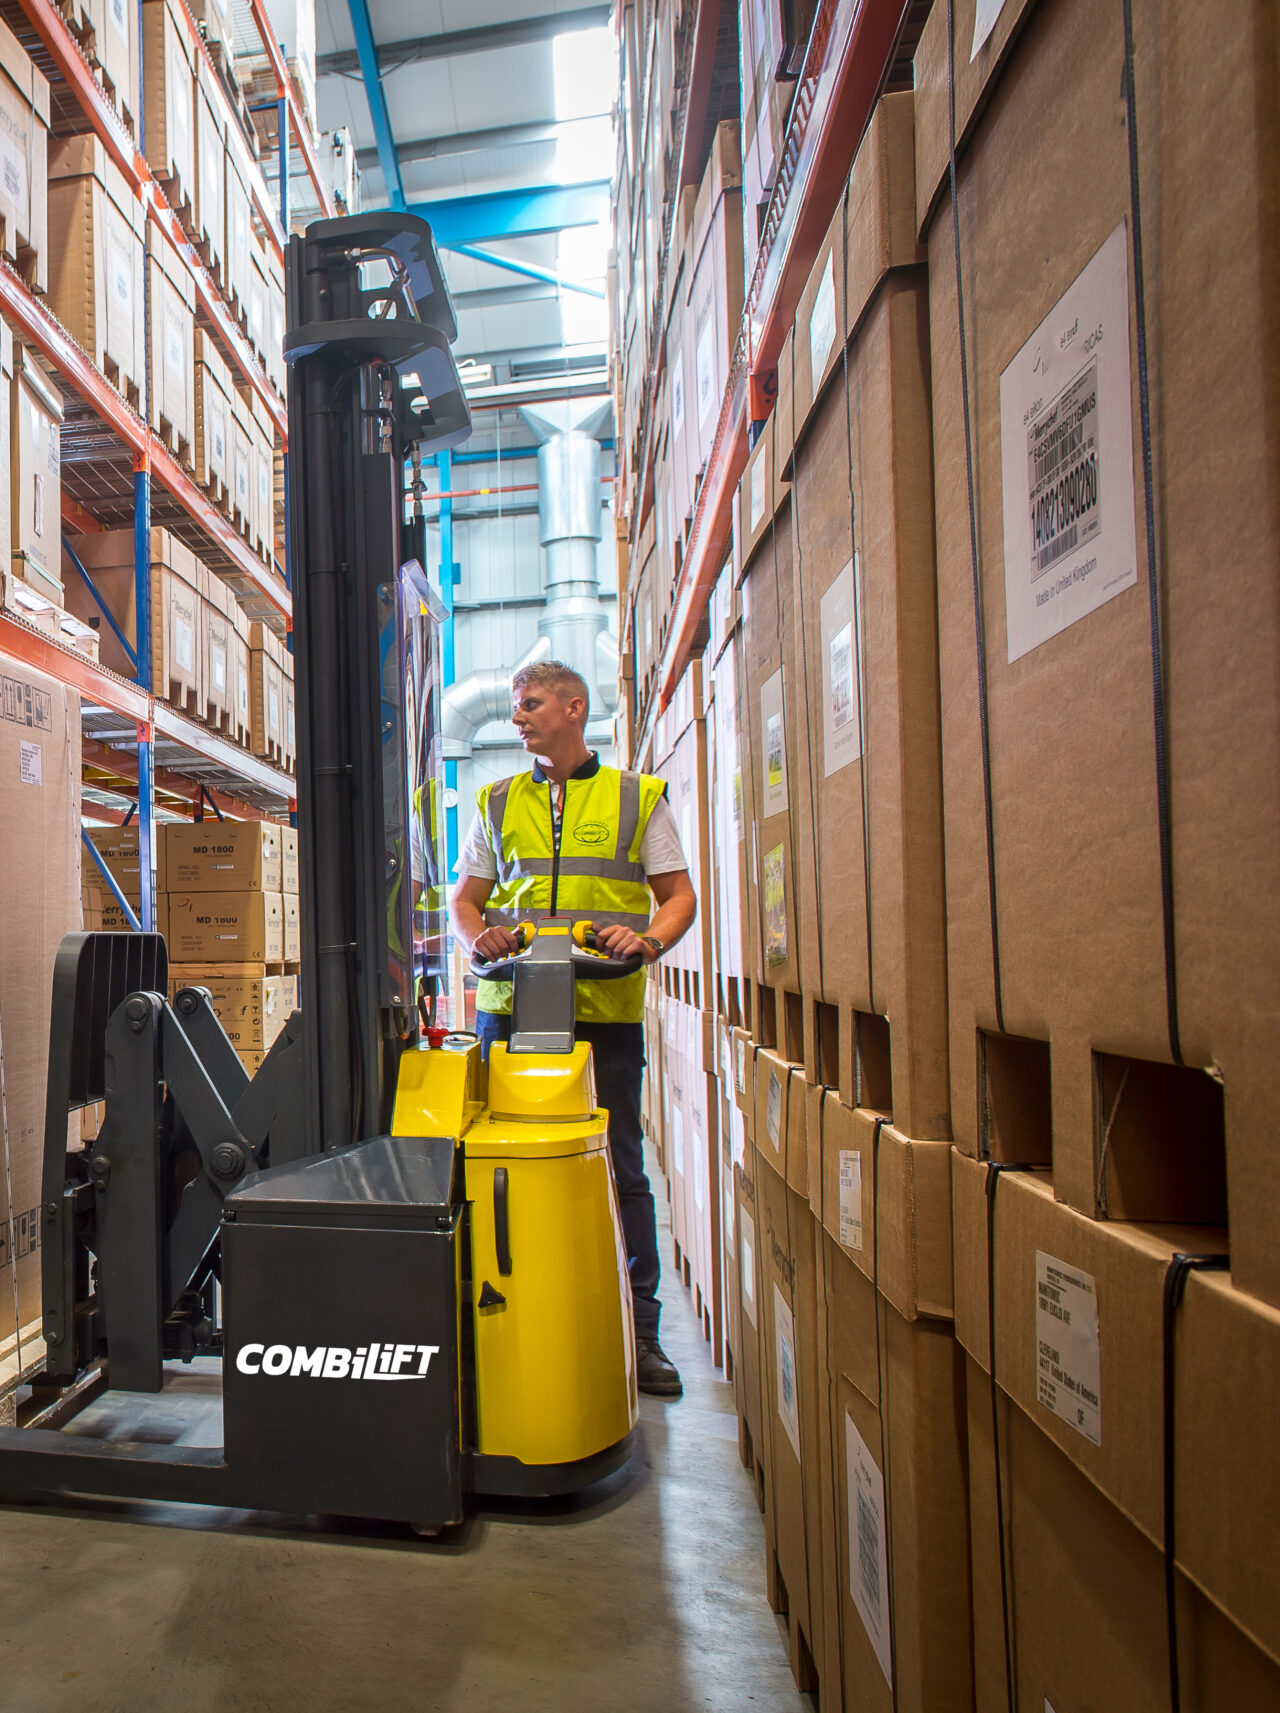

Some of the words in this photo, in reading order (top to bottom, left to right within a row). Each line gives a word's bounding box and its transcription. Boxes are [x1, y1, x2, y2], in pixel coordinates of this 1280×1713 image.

[1031, 451, 1098, 551] 1408213090280
[1035, 591, 1050, 608] Made
[1050, 586, 1056, 599] in
[1056, 574, 1073, 594] United
[1073, 556, 1098, 581] Kingdom
[193, 846, 208, 854] MD
[211, 845, 234, 854] 1800
